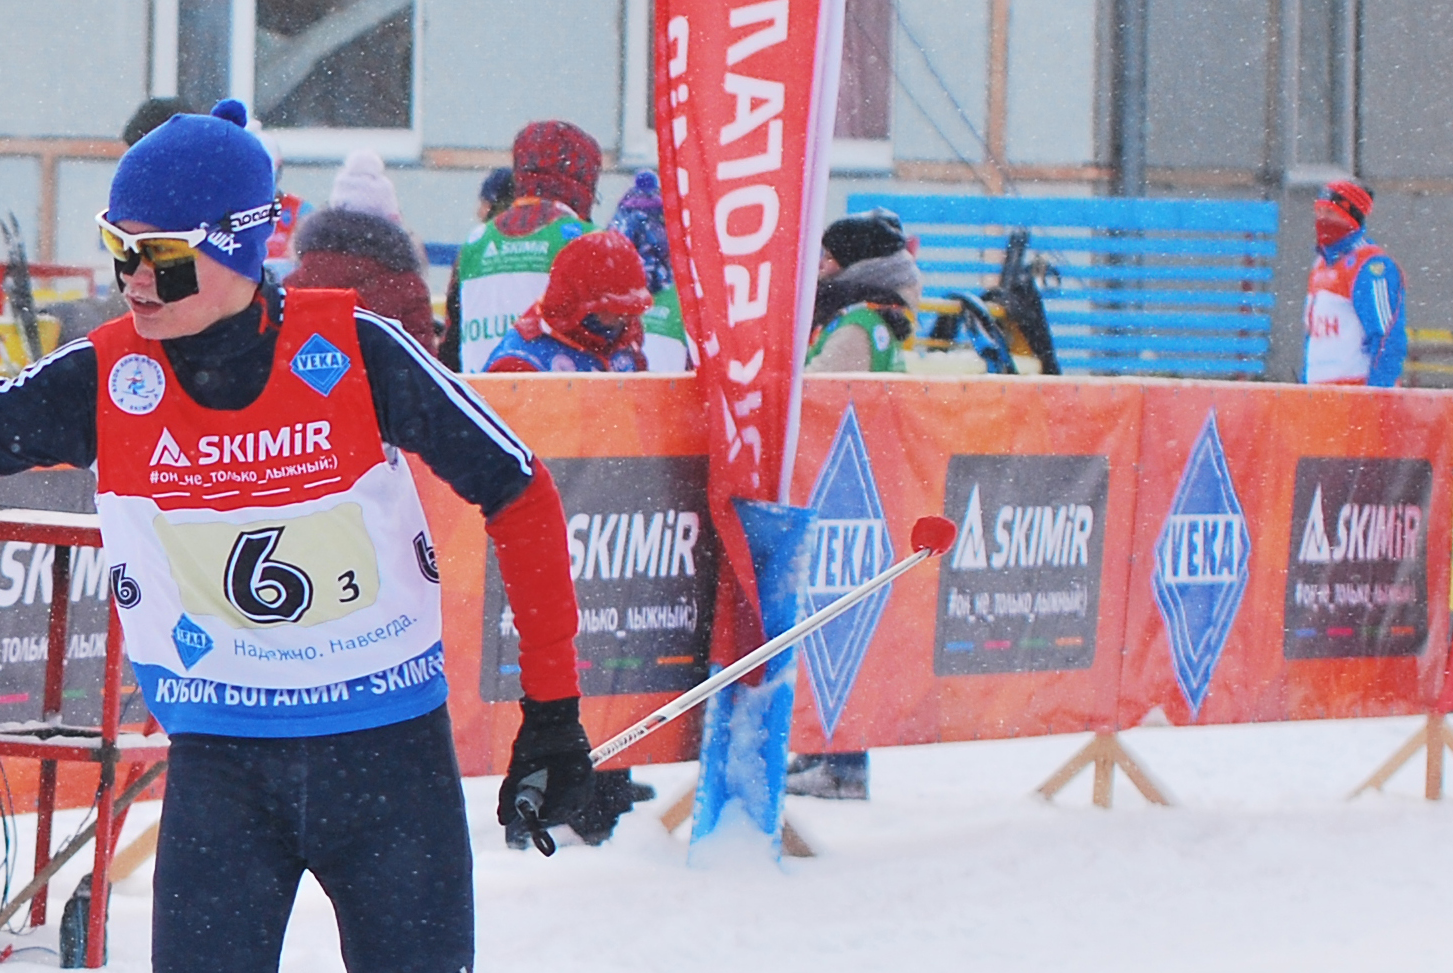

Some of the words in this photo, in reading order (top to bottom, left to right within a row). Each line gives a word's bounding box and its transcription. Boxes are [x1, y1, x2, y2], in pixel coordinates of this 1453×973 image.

[298, 352, 344, 371] VEKA
[198, 421, 332, 466] SKIMiR
[567, 508, 699, 581] SKIMiR
[990, 502, 1094, 570] SKIMiR
[1170, 520, 1235, 577] VEKA
[1332, 502, 1423, 563] SKIMiR
[109, 563, 142, 610] 6
[224, 526, 314, 624] 6
[337, 569, 361, 603] 3
[329, 612, 418, 654] Навсегда.
[155, 677, 219, 704] КУБОК
